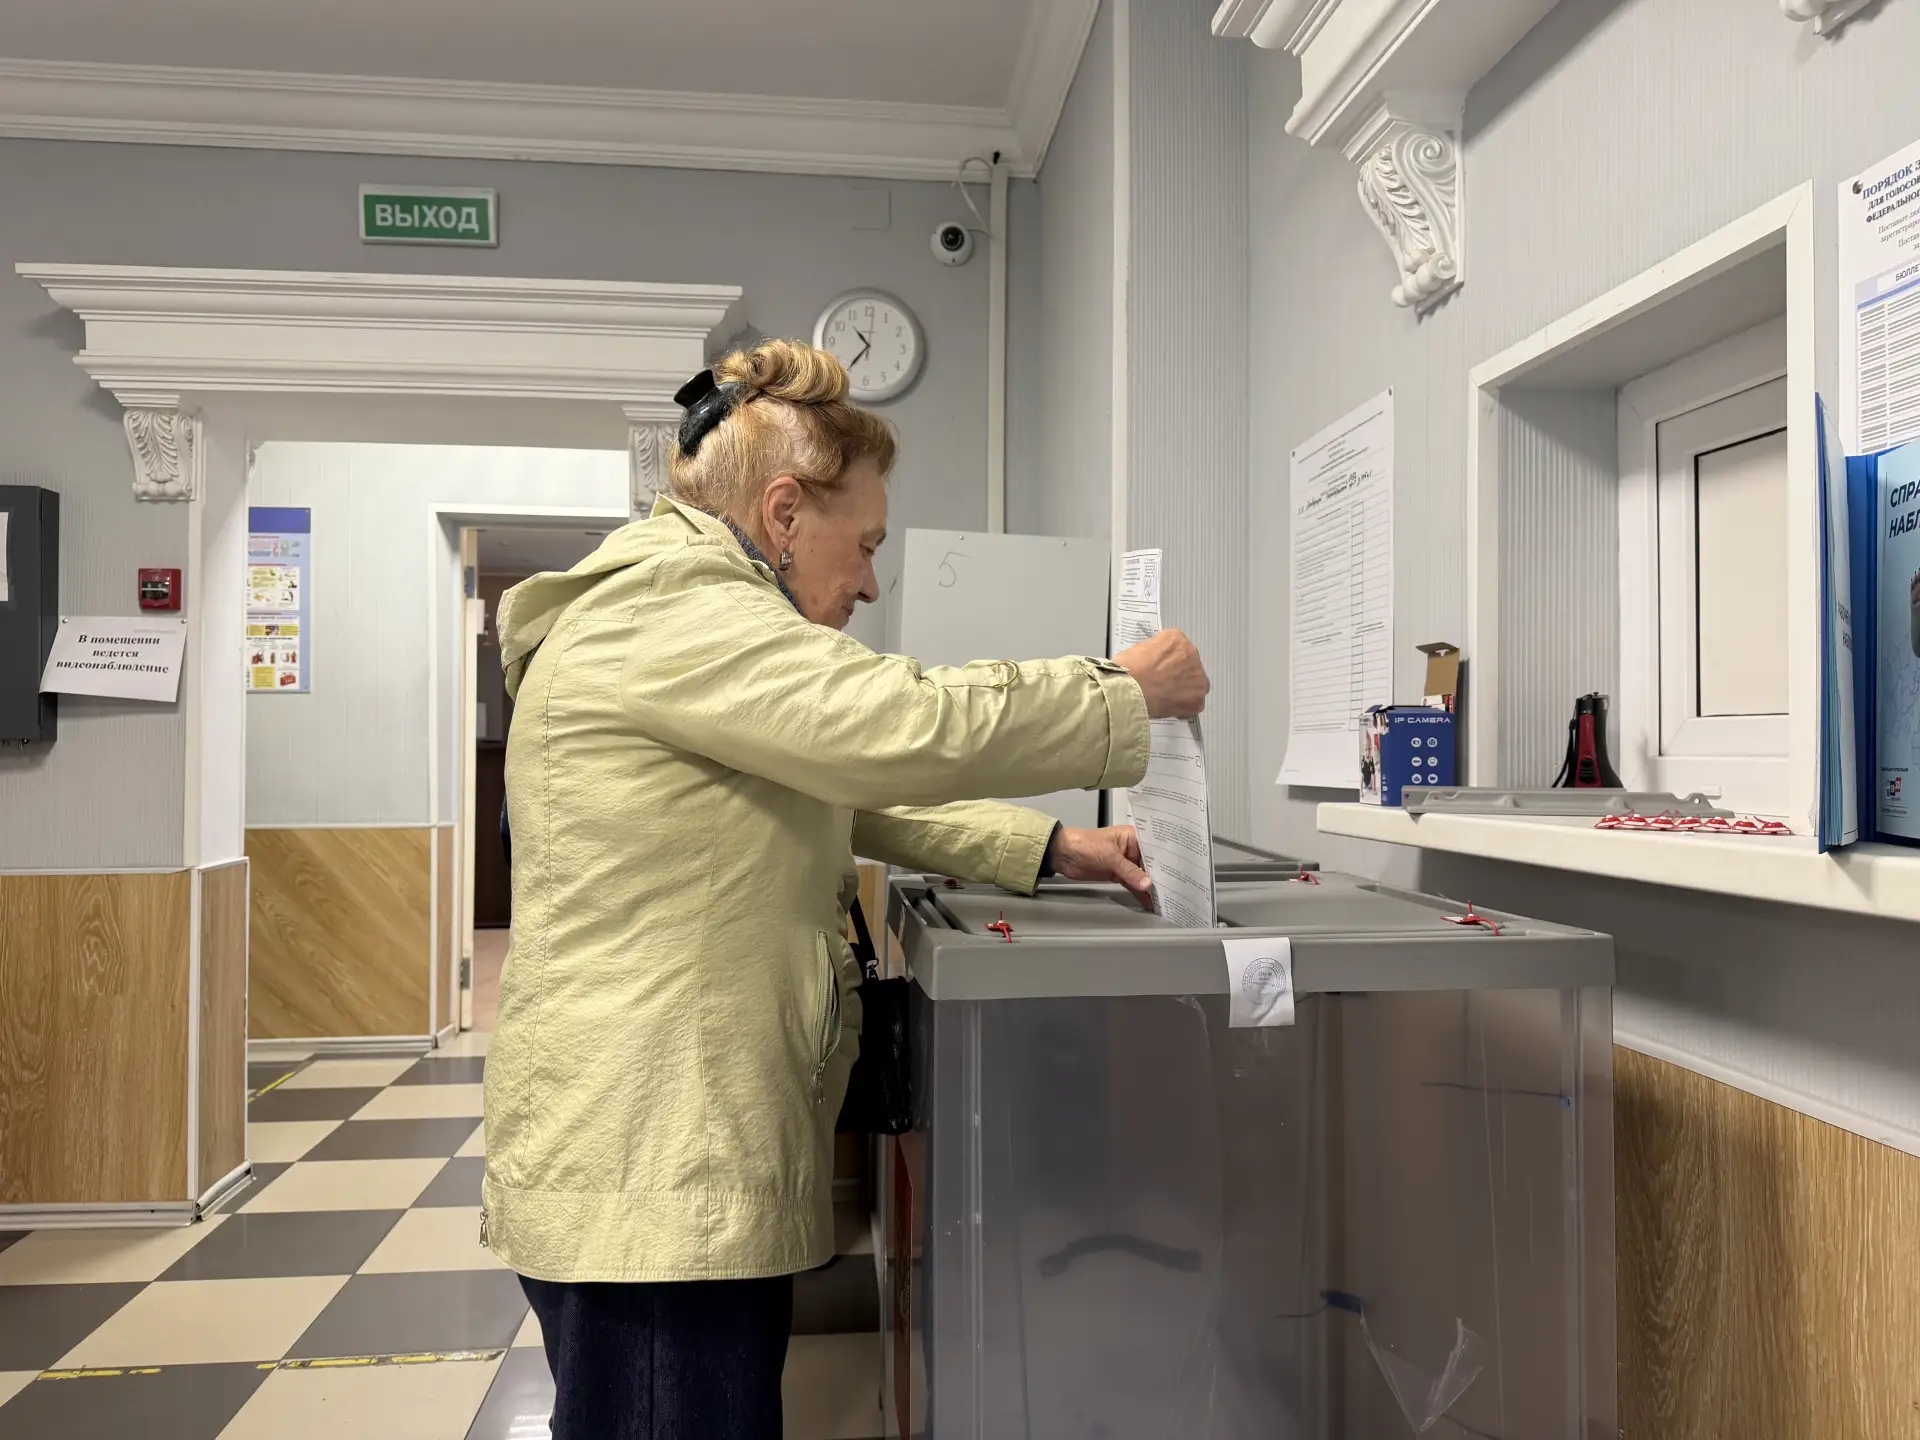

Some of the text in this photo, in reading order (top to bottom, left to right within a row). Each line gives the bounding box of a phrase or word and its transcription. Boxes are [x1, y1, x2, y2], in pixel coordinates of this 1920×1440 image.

[1863, 164, 1912, 200] ПОРЯДОК
[1868, 195, 1884, 211] ДЛЯ
[375, 203, 479, 233] ВЫХОД
[848, 310, 857, 320] 11
[864, 306, 875, 317] 12
[884, 313, 888, 324] 1
[835, 321, 846, 332] 10
[895, 326, 902, 337] 2
[828, 336, 836, 348] 9
[900, 344, 907, 354] 3
[894, 361, 900, 371] 4
[862, 375, 870, 386] 6
[880, 371, 887, 382] 5
[938, 551, 973, 588] 5
[78, 634, 160, 646] В помещении
[92, 649, 139, 659] ведется
[56, 660, 169, 675] видеонаблюдение
